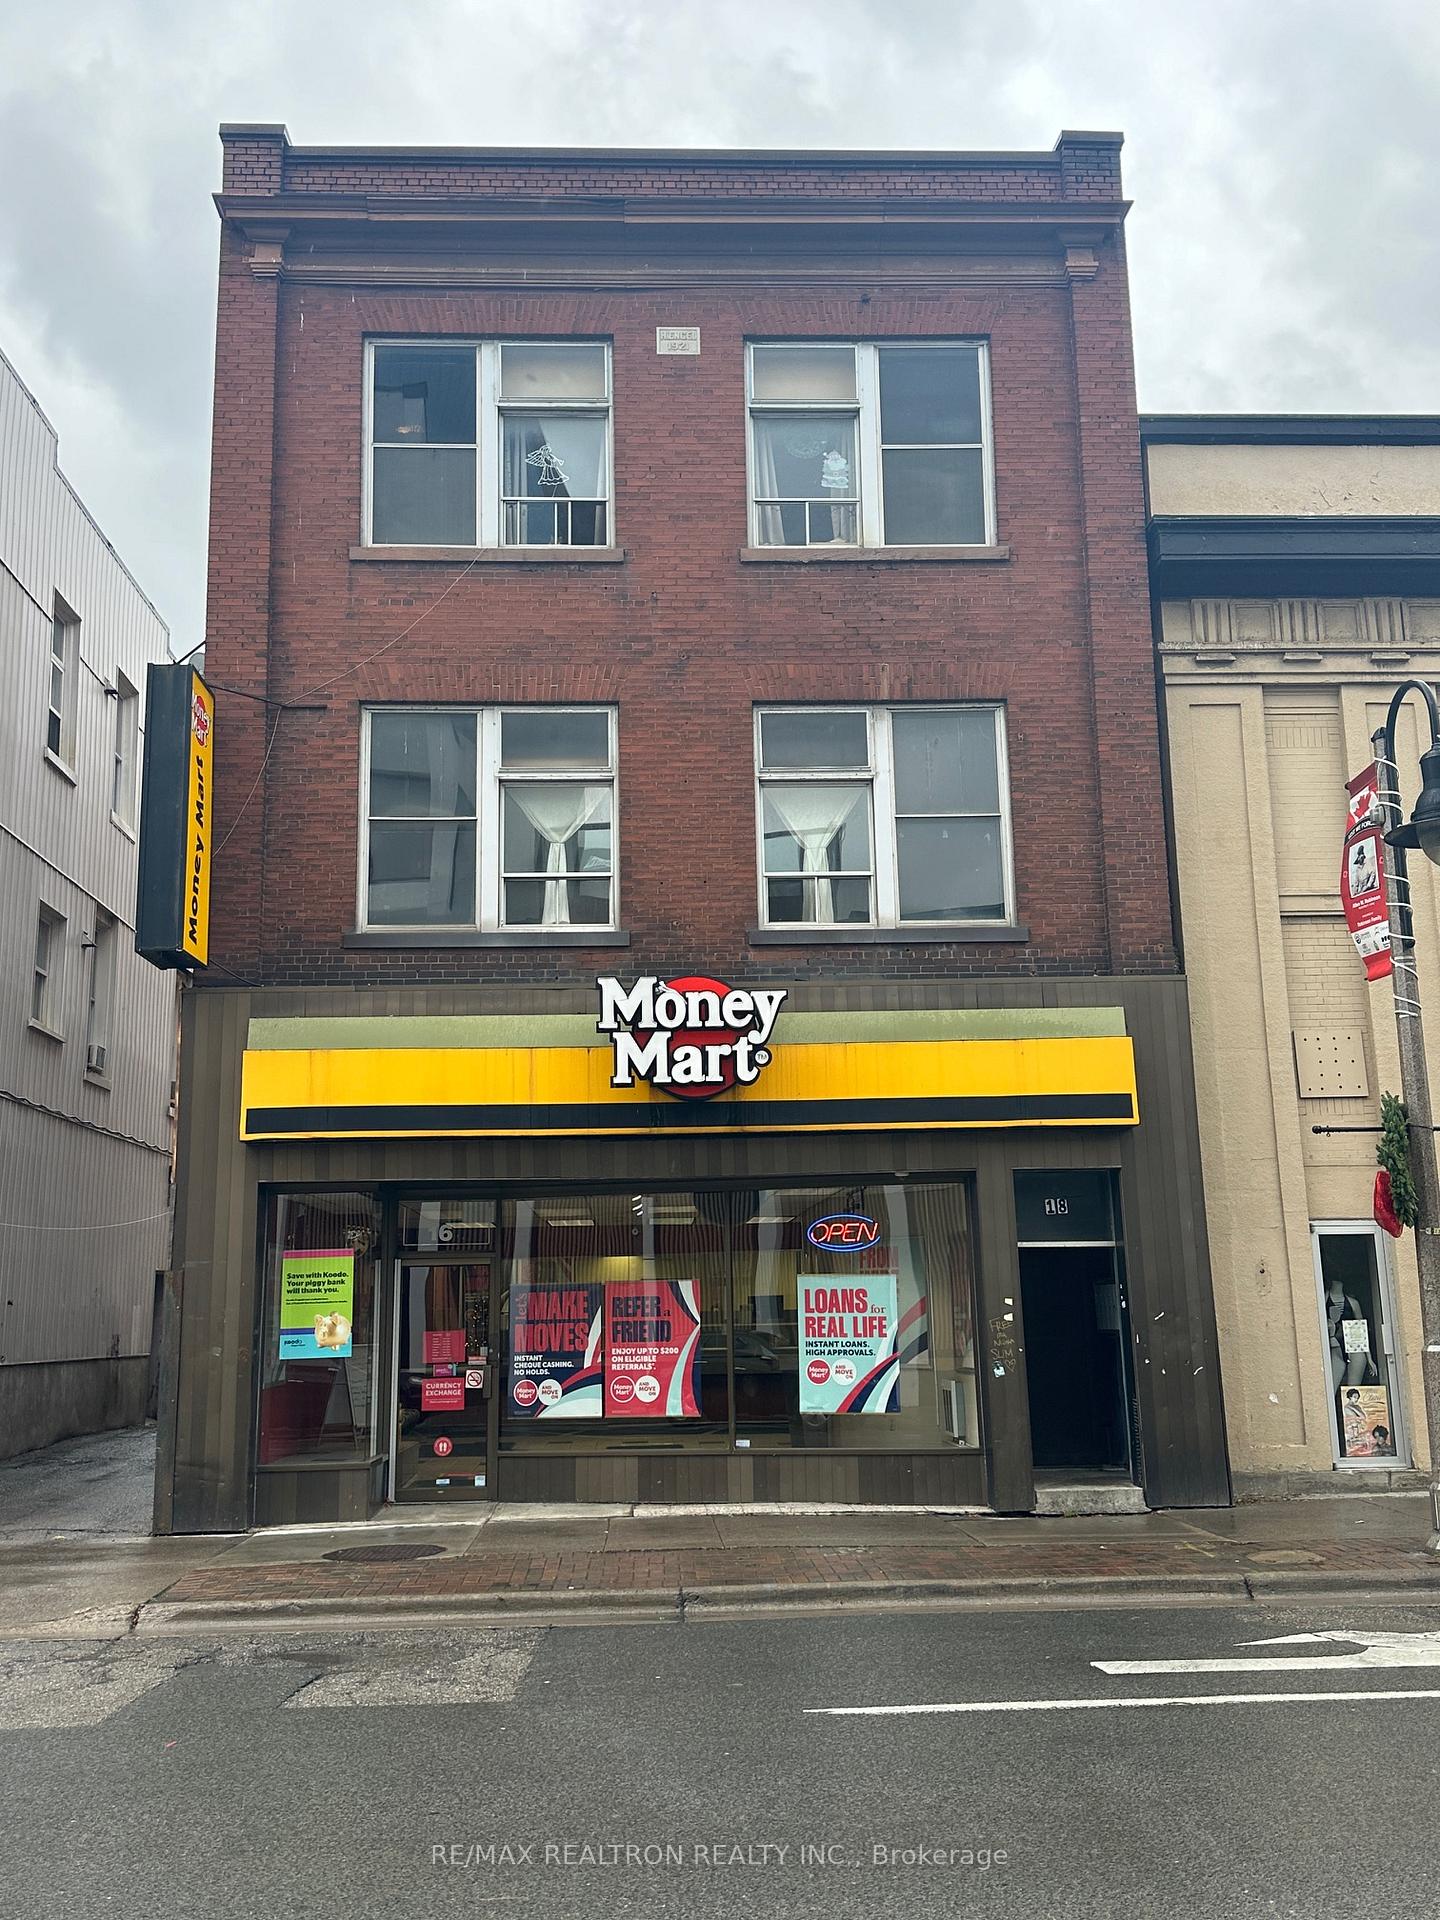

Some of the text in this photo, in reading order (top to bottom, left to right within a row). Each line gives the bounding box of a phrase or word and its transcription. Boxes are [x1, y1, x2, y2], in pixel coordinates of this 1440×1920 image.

[667, 342, 690, 351] 1921
[188, 755, 206, 946] Money Mart
[597, 976, 788, 1044] Money
[612, 1031, 759, 1084] Mart
[1046, 1199, 1067, 1215] 18
[810, 1222, 878, 1242] OPEN
[306, 1271, 322, 1279] with
[527, 1290, 589, 1320] MAKE
[612, 1296, 671, 1317] REFER a
[804, 1288, 886, 1314] LOANS for
[612, 1320, 672, 1343] FRIEND
[804, 1316, 888, 1338] REAL LIFE
[514, 1322, 589, 1353] MOVES
[513, 1354, 543, 1362] INSTANT
[611, 1347, 637, 1355] ENJOY
[611, 1355, 657, 1363] ON ELIGIBLE
[525, 1368, 550, 1376] HOLDS.
[425, 1389, 462, 1397] EXCHANGE
